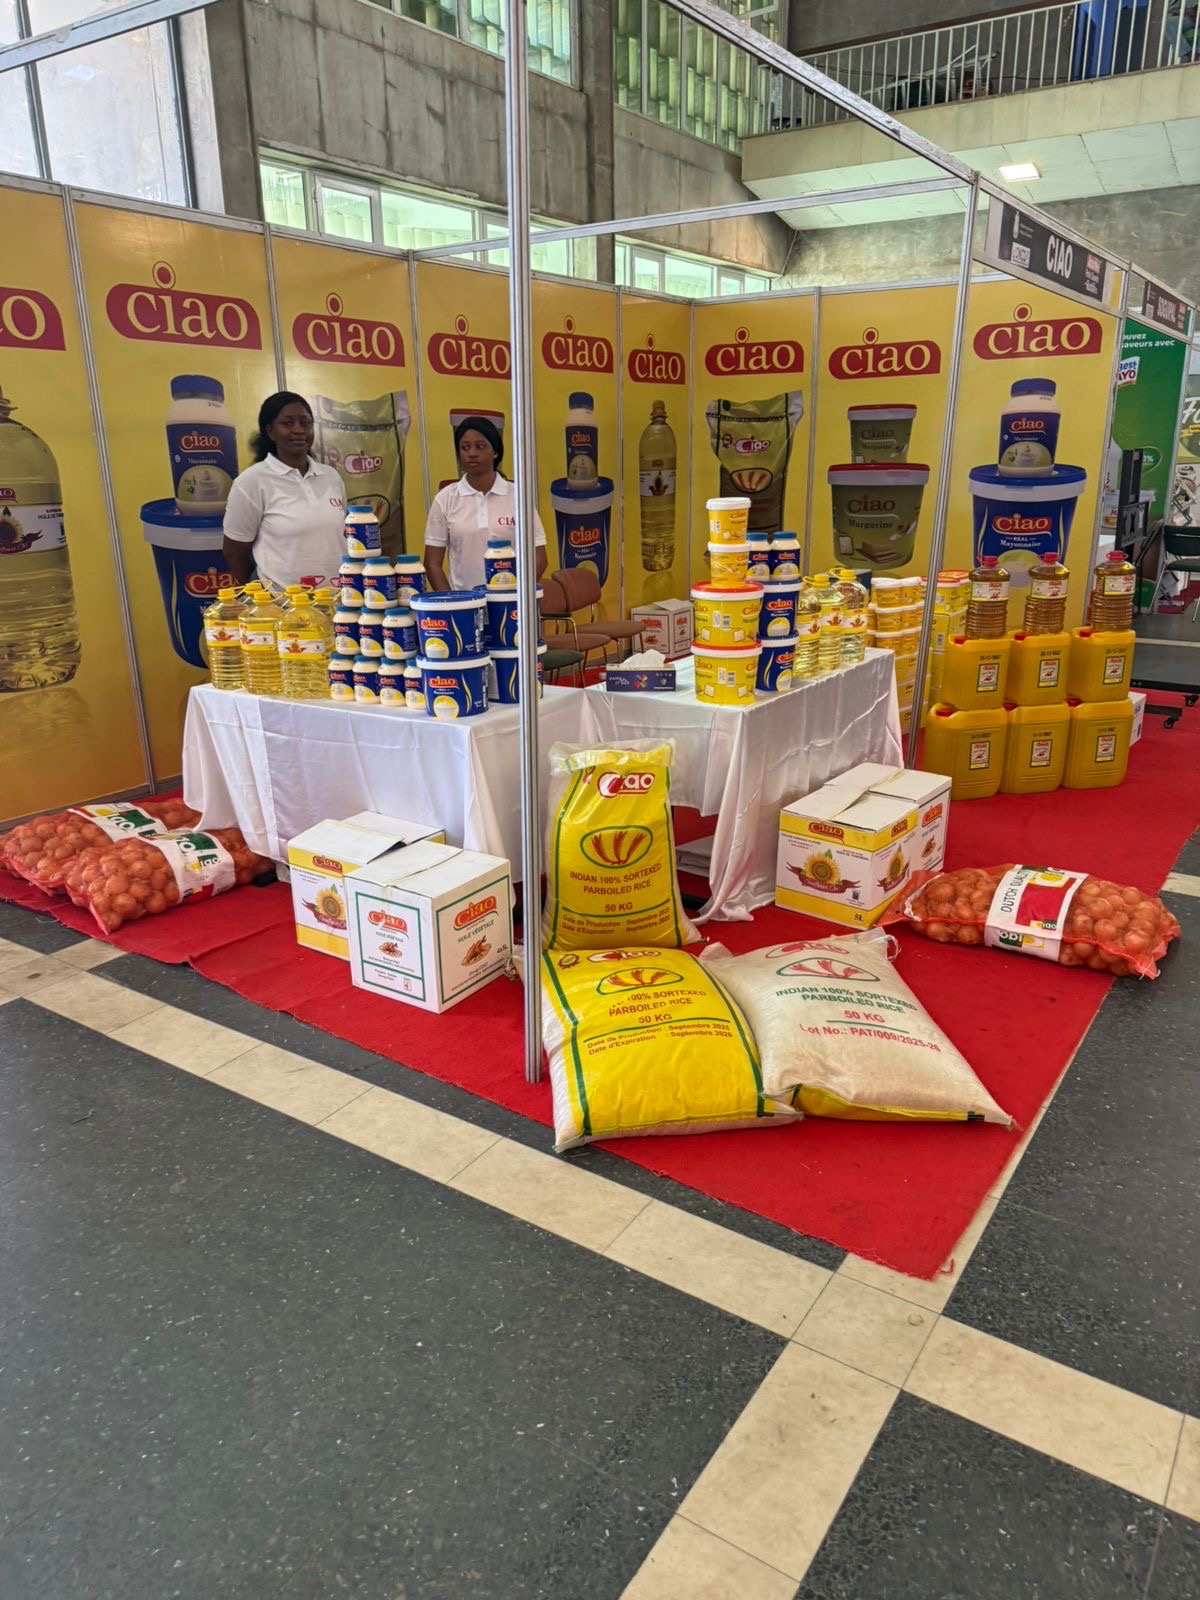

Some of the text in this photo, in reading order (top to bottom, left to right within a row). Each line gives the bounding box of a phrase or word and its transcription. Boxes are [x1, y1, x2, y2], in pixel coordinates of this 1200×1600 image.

[1047, 235, 1073, 279] CIAO
[127, 261, 248, 341] ciao
[306, 292, 395, 360] ciao
[988, 303, 1091, 355] ciao
[551, 315, 608, 368] ciao
[717, 327, 795, 371] ciao
[841, 327, 931, 375] ciao
[635, 333, 681, 380] ciao
[330, 498, 343, 507] CIA
[498, 516, 515, 526] CIA
[189, 567, 234, 592] Cia
[570, 863, 662, 884] INDIAN 100% SORTEXED
[583, 879, 651, 895] PARBOILED RICE
[605, 902, 633, 912] 50 KG
[1000, 888, 1018, 913] DUTCH
[562, 914, 575, 922] Date
[586, 919, 622, 928] Production
[562, 922, 575, 930] Date
[653, 989, 706, 999] SORTEXED
[776, 987, 918, 1011] INDIAN 100% SORTEXED
[802, 994, 905, 1014] PARBOILED RICE
[609, 1001, 667, 1016] PARBOILED
[669, 997, 693, 1005] RICE
[844, 1010, 886, 1023] 50 KG
[638, 1014, 673, 1024] 50 KG
[799, 1024, 820, 1034] Lot
[587, 1040, 605, 1049] Date
[619, 1027, 663, 1039] Production
[668, 1023, 711, 1031] Septembre
[589, 1046, 607, 1055] Date
[609, 1035, 657, 1050] d'Expiration
[670, 1030, 713, 1039] Septembre
